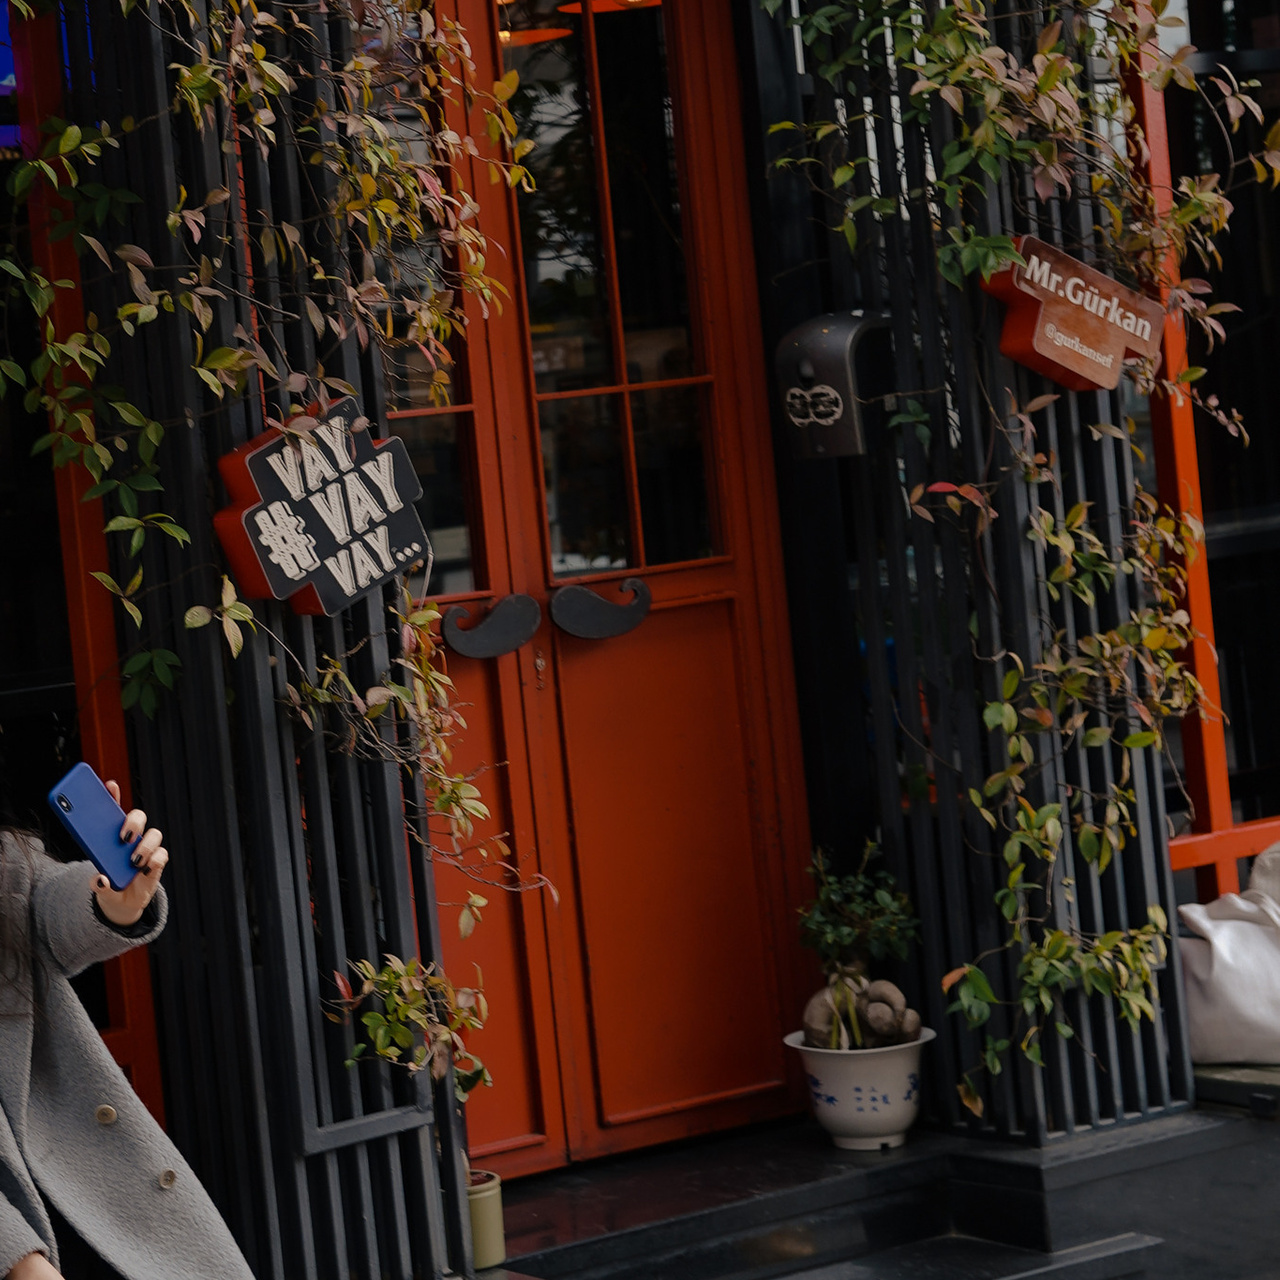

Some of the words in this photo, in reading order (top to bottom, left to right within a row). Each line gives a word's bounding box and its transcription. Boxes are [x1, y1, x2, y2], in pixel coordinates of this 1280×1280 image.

[1024, 254, 1152, 342] Mr.Gürkan
[265, 416, 355, 502] VAY
[308, 451, 404, 546] VAY
